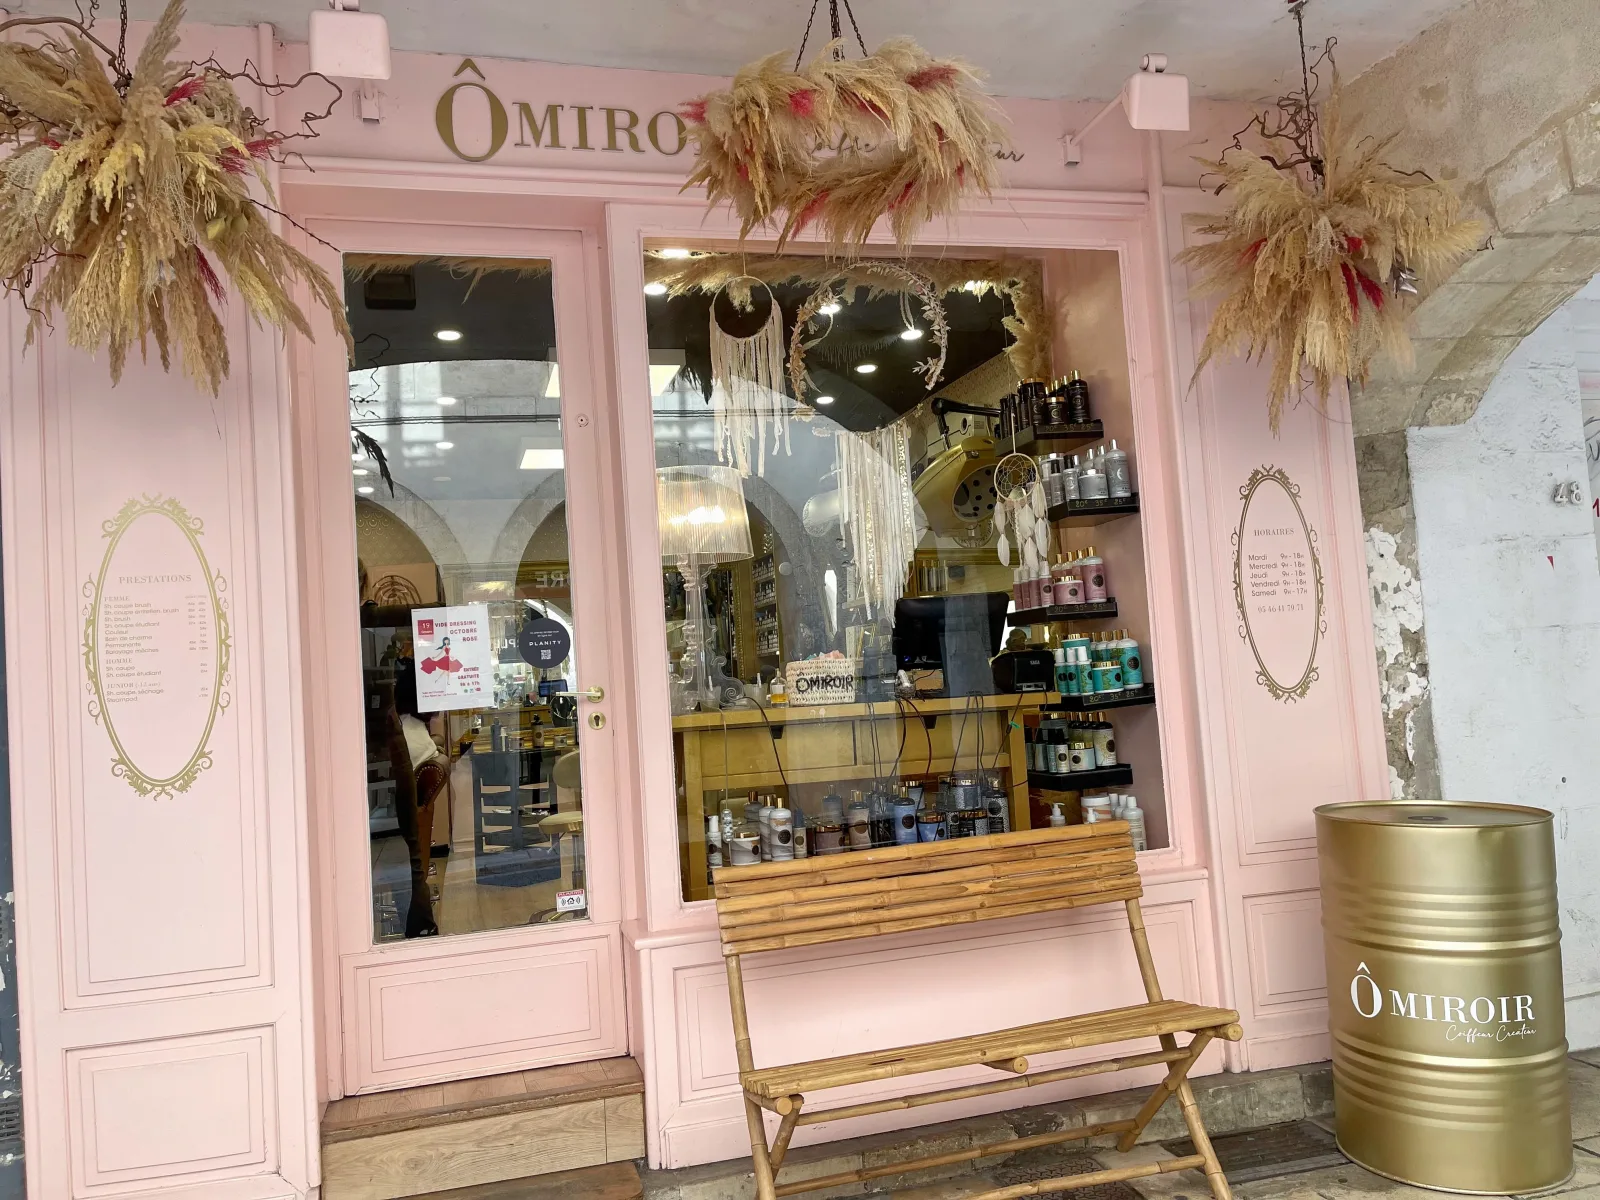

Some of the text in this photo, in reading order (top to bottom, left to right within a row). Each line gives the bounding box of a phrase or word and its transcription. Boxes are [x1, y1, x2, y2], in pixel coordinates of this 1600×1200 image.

[1552, 481, 1583, 506] 48
[1254, 528, 1295, 536] HORAIRES
[119, 575, 192, 584] PRESTATIONS
[1445, 1024, 1494, 1043] Coiffeur
